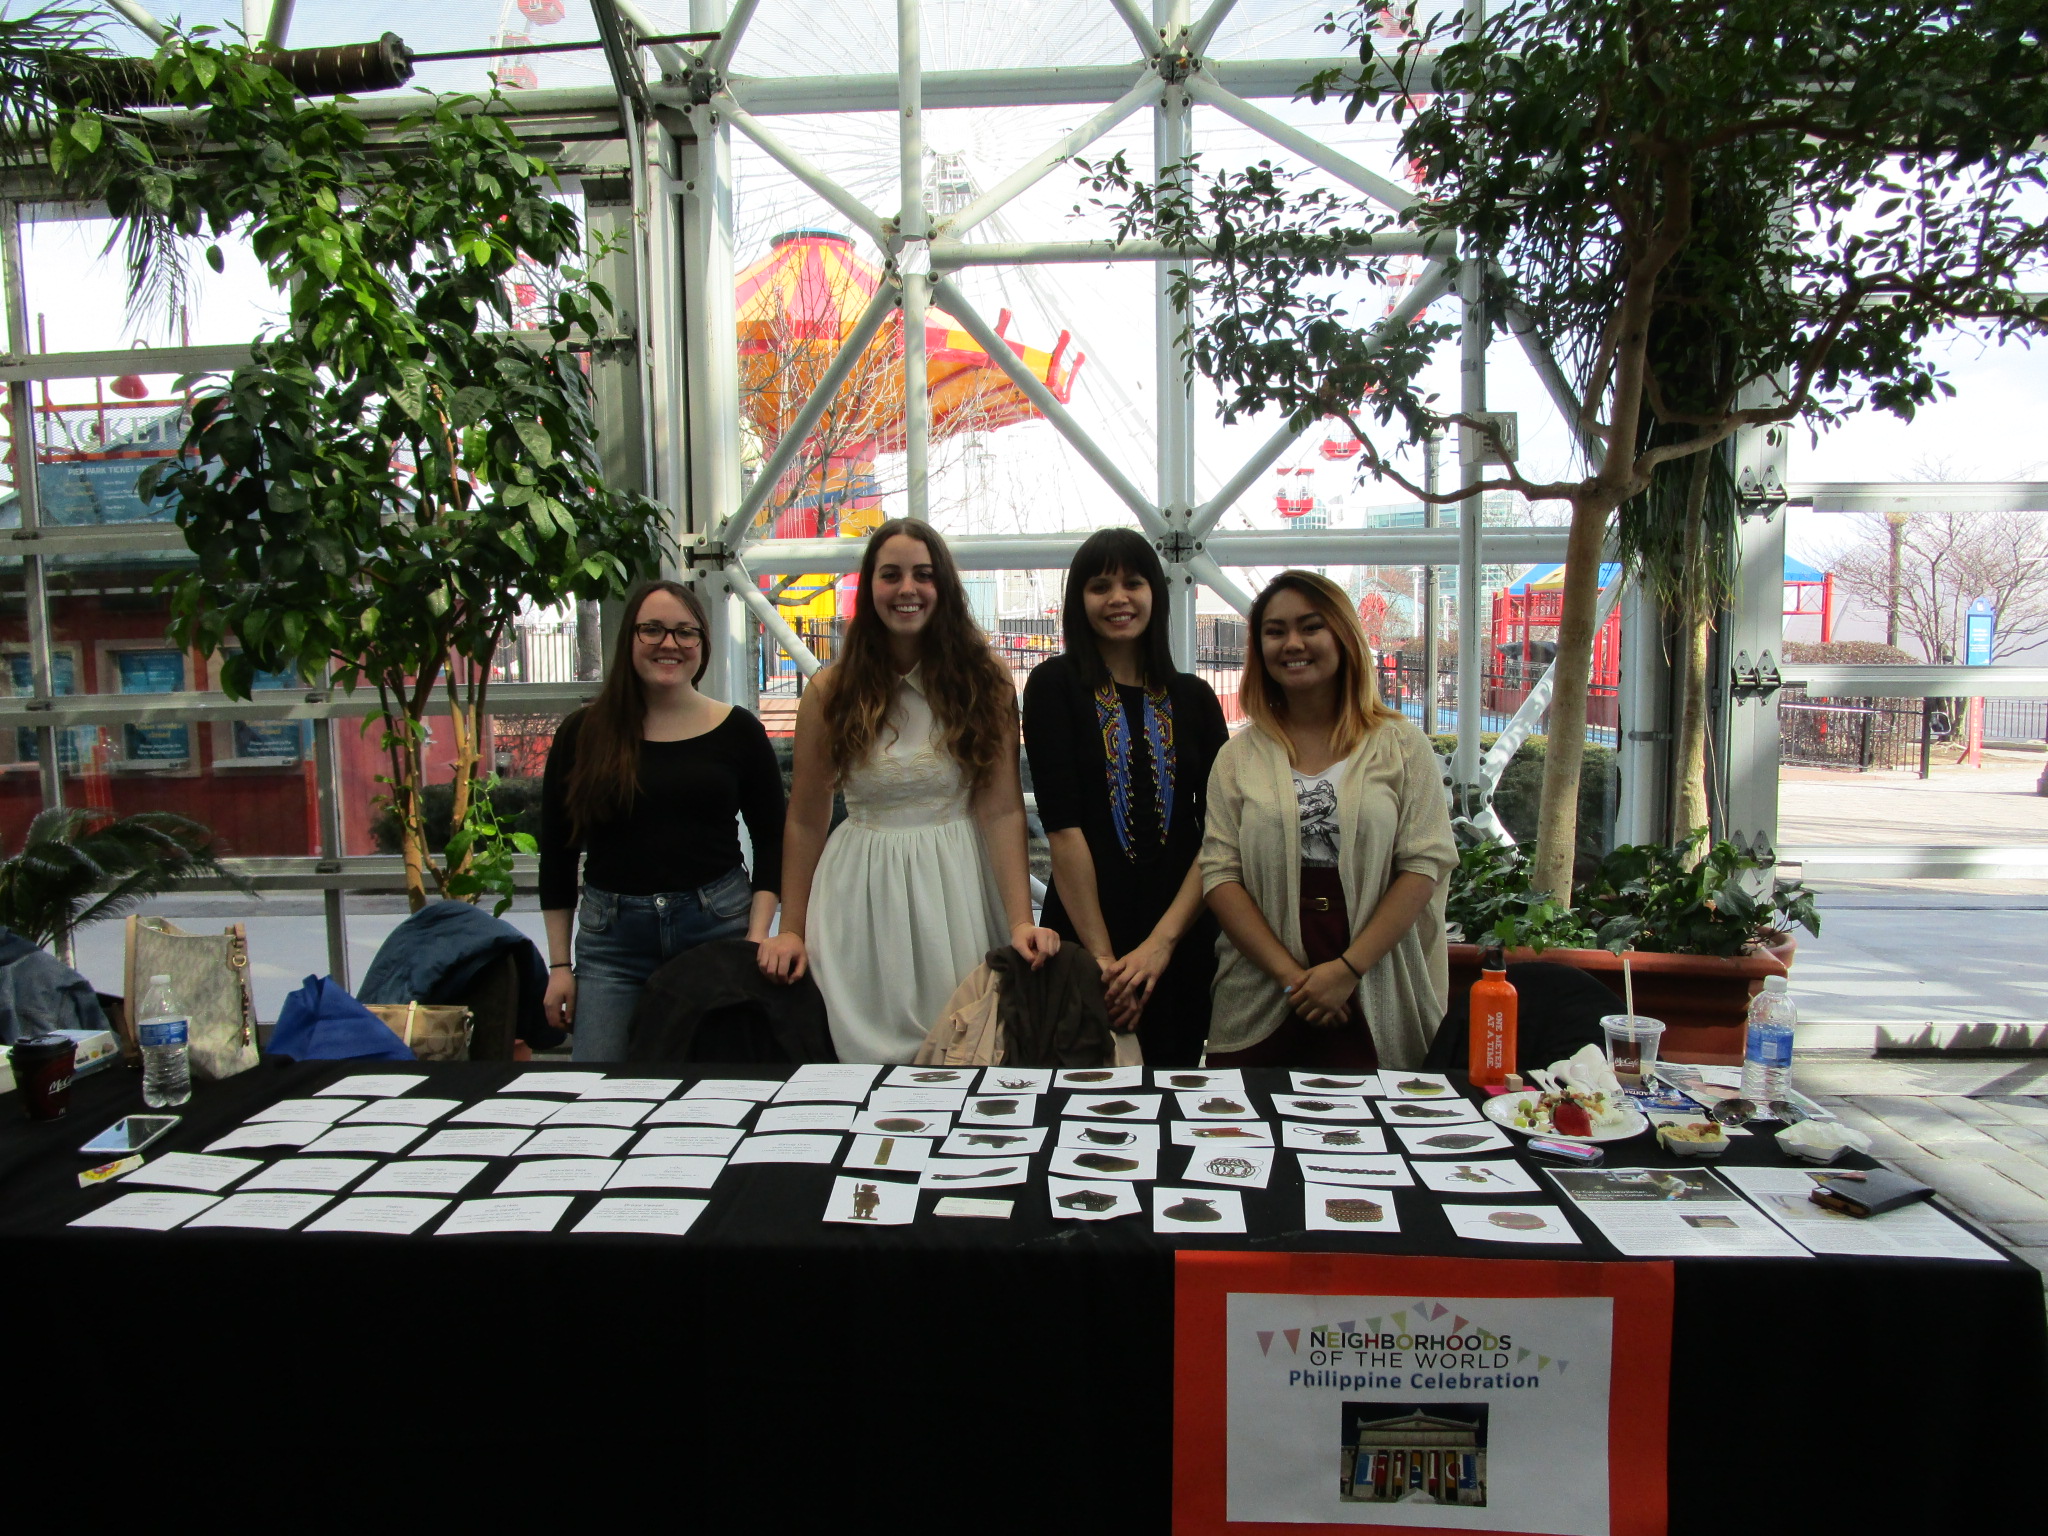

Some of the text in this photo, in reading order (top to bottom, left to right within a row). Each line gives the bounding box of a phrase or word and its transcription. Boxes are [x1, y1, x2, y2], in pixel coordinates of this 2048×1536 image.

[68, 468, 85, 476] PIER
[86, 467, 107, 475] PARK
[108, 465, 135, 474] TICKET
[1486, 1013, 1495, 1069] AT A TIME
[1494, 1011, 1503, 1069] ONE METER
[1310, 1331, 1512, 1351] NEIGHBORHOODS
[1310, 1350, 1509, 1370] OF THE WORLD
[1289, 1369, 1540, 1391] Philippine Celebration
